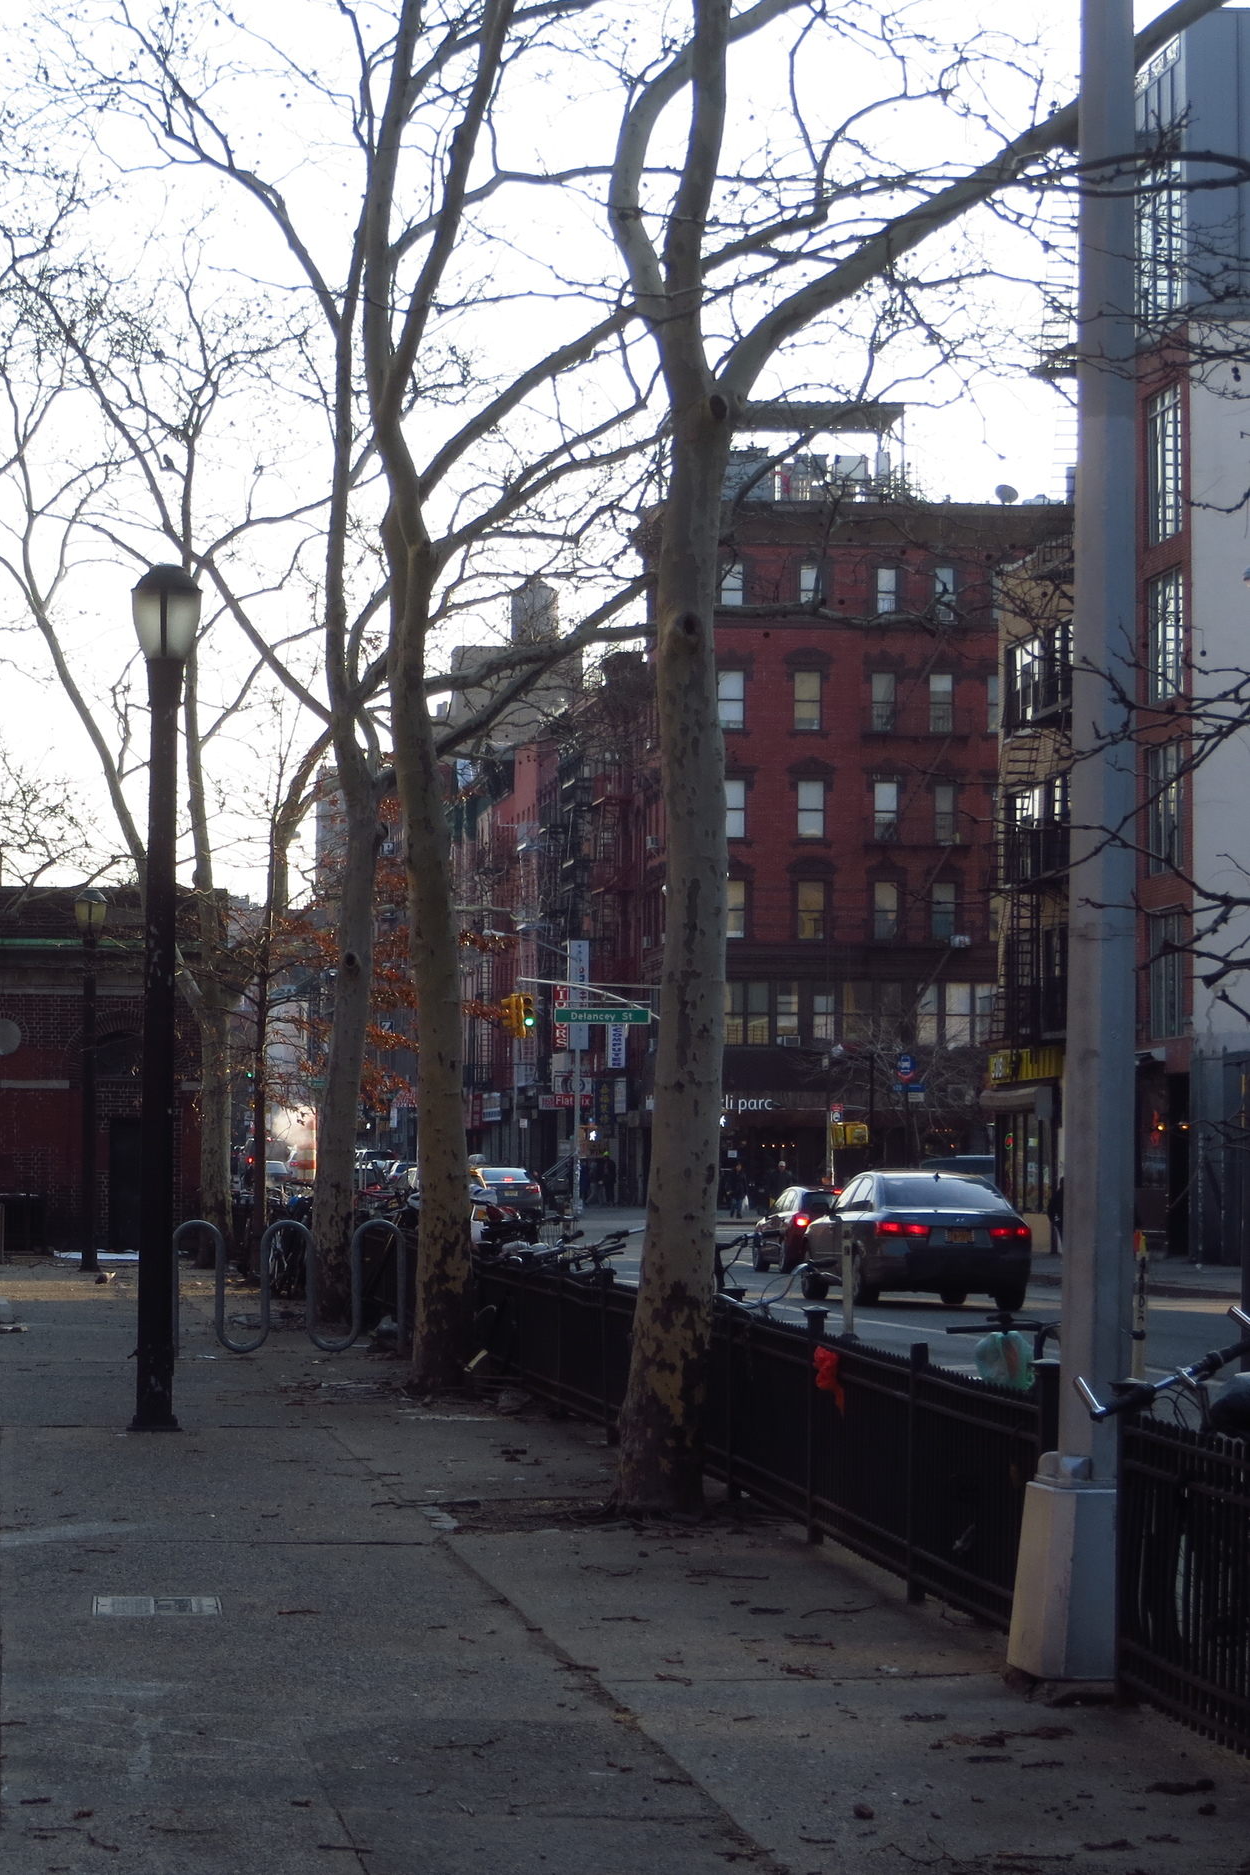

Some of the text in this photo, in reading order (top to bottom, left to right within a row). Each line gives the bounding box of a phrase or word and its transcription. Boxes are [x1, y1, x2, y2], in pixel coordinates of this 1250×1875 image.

[570, 1012, 632, 1022] Delancey St
[555, 1095, 573, 1106] Flat
[738, 1099, 773, 1114] parc
